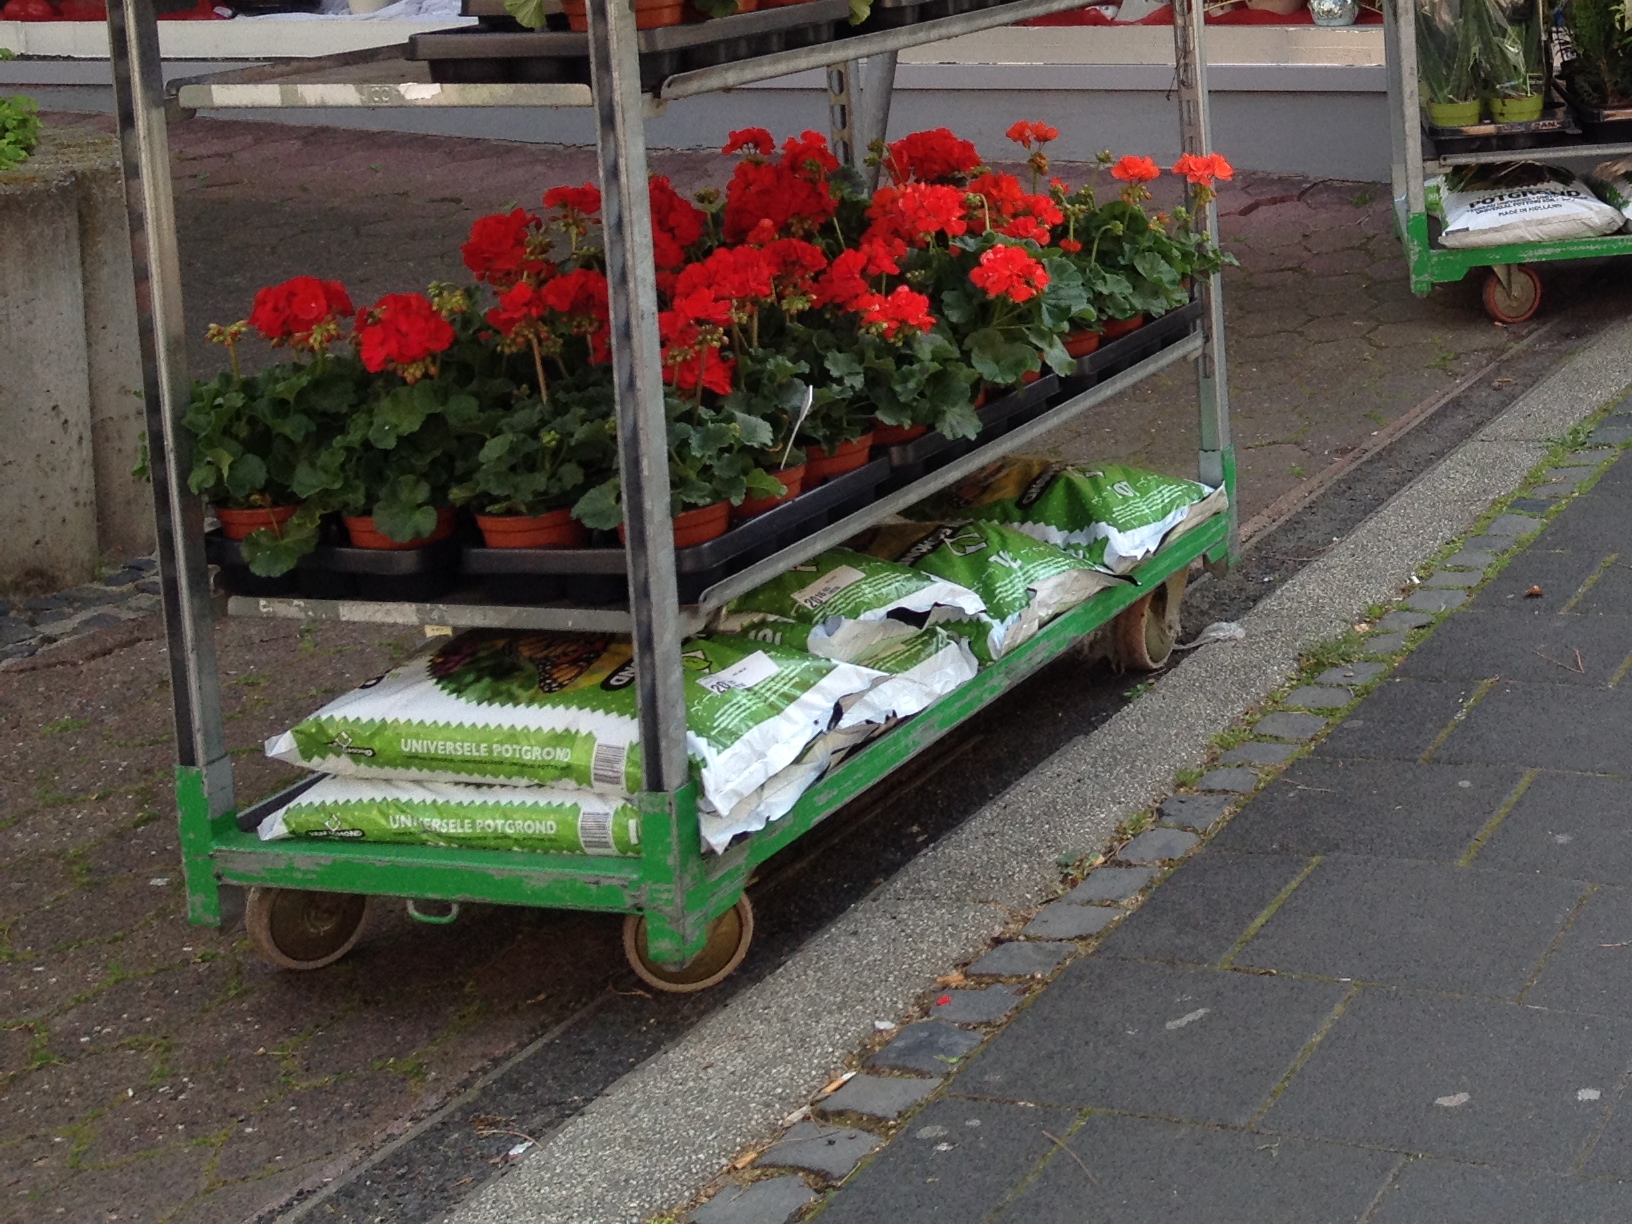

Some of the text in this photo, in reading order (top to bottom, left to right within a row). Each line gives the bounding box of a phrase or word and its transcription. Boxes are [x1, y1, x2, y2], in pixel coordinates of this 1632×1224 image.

[400, 738, 572, 762] UNIVERSELE POTGROND
[476, 819, 557, 834] POTGROND
